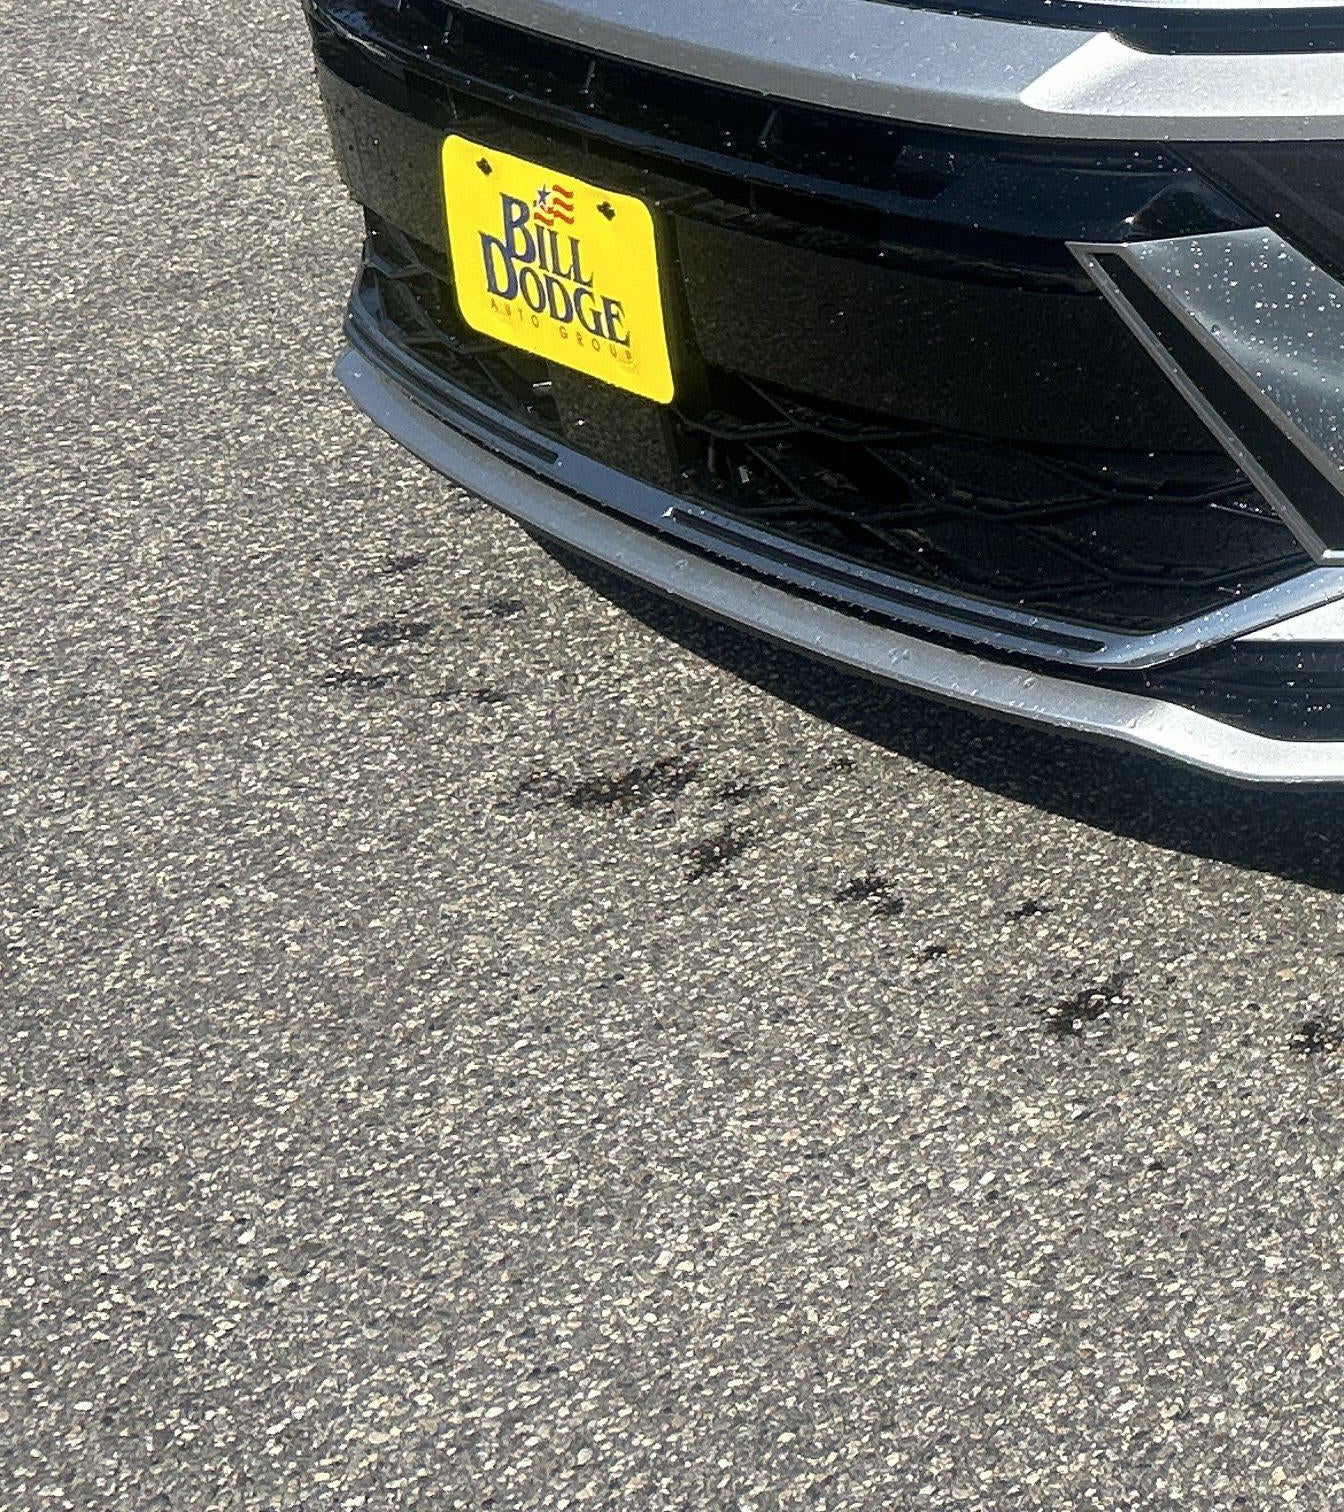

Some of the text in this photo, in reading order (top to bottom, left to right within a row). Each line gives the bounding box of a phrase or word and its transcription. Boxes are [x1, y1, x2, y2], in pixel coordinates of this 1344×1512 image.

[500, 192, 594, 288] BILL
[479, 231, 631, 347] DODGE
[491, 297, 632, 361] AUTO GROUP
